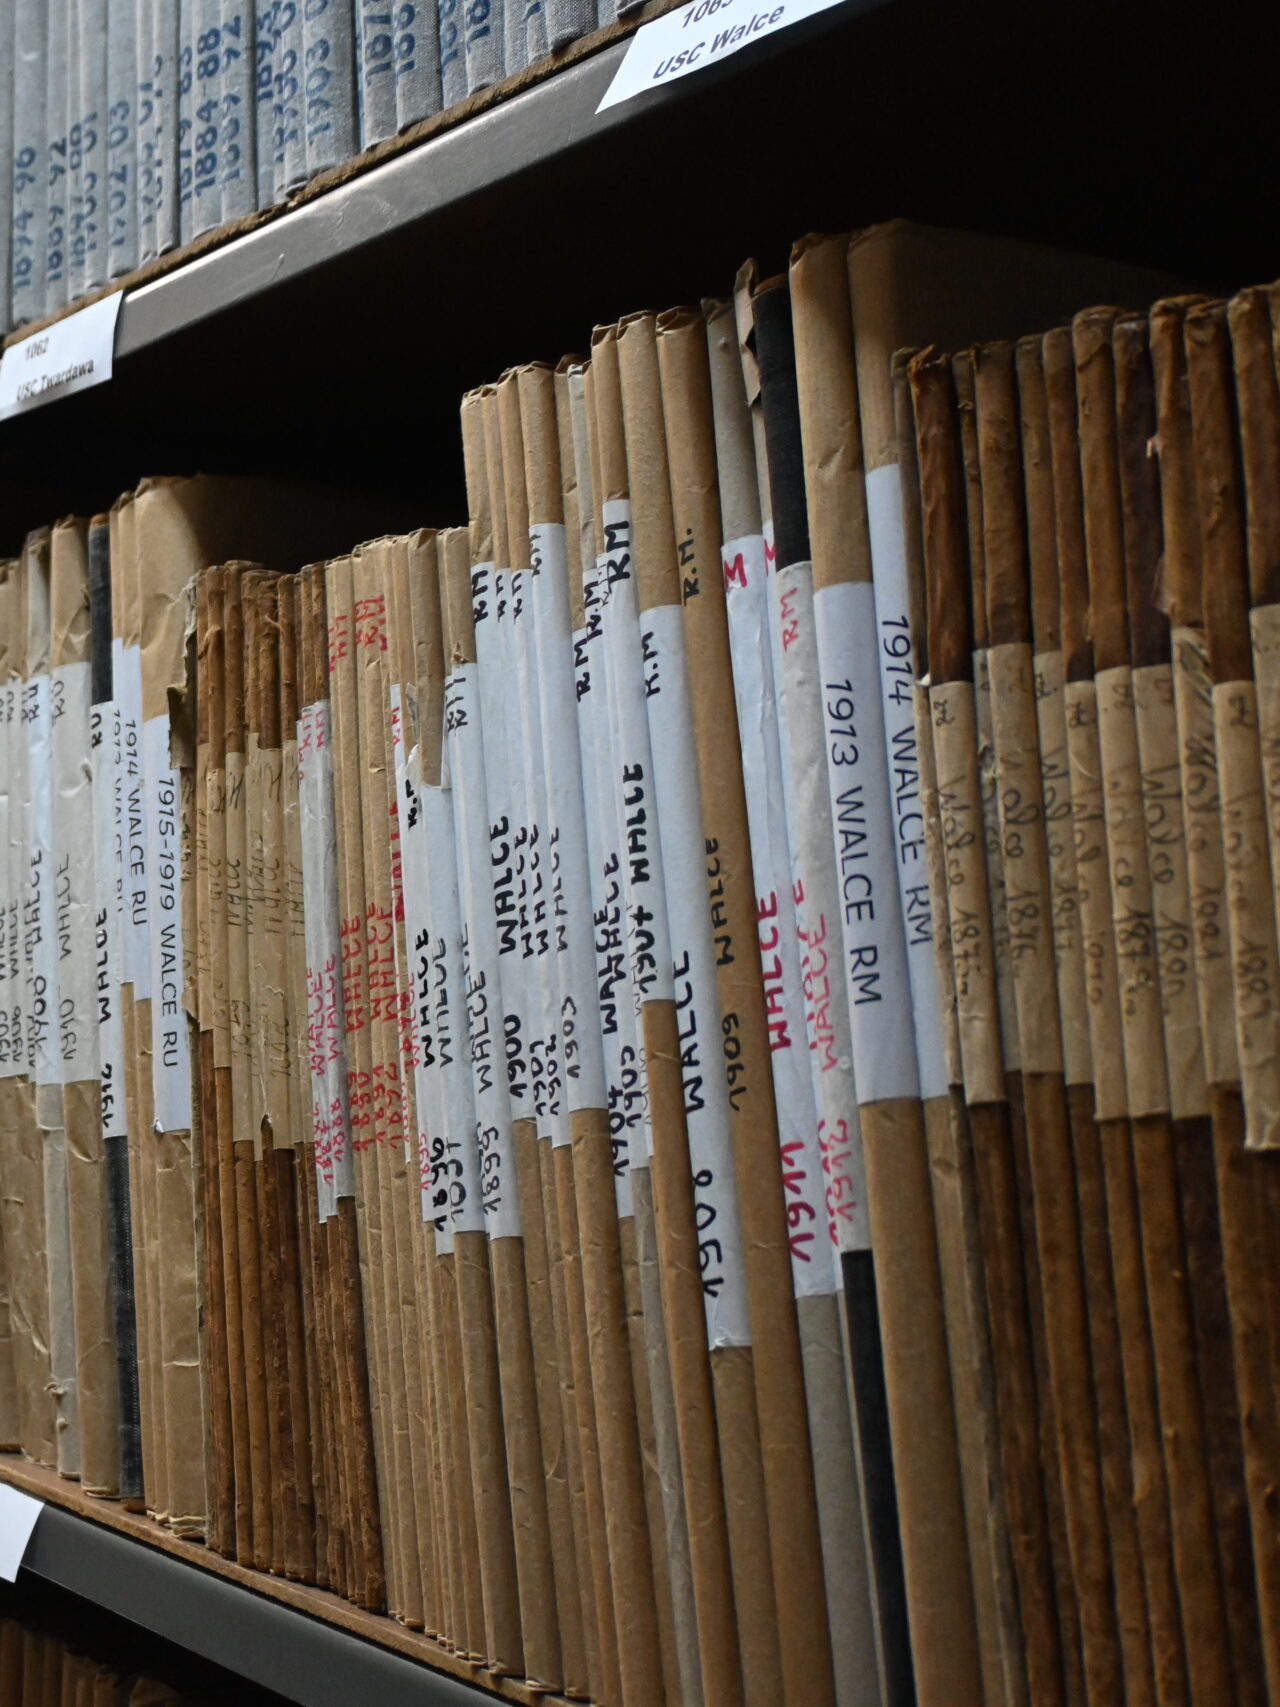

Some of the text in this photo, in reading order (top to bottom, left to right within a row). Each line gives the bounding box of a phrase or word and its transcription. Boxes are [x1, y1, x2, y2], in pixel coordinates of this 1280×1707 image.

[652, 5, 785, 79] USC Walce
[194, 27, 221, 198] 1884-88
[16, 380, 40, 401] USC
[25, 337, 49, 360] 1062
[881, 614, 914, 706] 1914
[125, 719, 148, 926] 1914 WALCE RU
[622, 763, 651, 886] WALCE
[825, 678, 883, 1007] 1913 WALCE RM
[891, 725, 926, 864] WALCE
[30, 849, 43, 944] WALCE
[57, 853, 73, 960] WALCE
[157, 776, 178, 1067] 1915-1919 WALCE RU
[490, 816, 519, 957] WALCE
[514, 827, 534, 960] WALCE
[529, 824, 549, 958] WALCE
[549, 827, 568, 955] WALCE
[604, 852, 627, 983] WALCE
[705, 837, 736, 967] WALCE
[95, 907, 112, 1024] WALCE
[324, 953, 344, 1061] WALCE
[415, 928, 436, 1068] WALCE
[593, 904, 618, 1035] WALCE
[807, 914, 839, 1073] WALCE
[468, 970, 493, 1094] WALCE
[503, 1015, 528, 1100] 1900
[529, 1040, 548, 1118] 1901
[544, 1034, 562, 1118] 1902
[561, 996, 581, 1081] 1903
[673, 950, 705, 1115] WALCE
[722, 1012, 747, 1112] 1909
[755, 891, 816, 1263] 1911 WALCE
[608, 1084, 630, 1177] 1904
